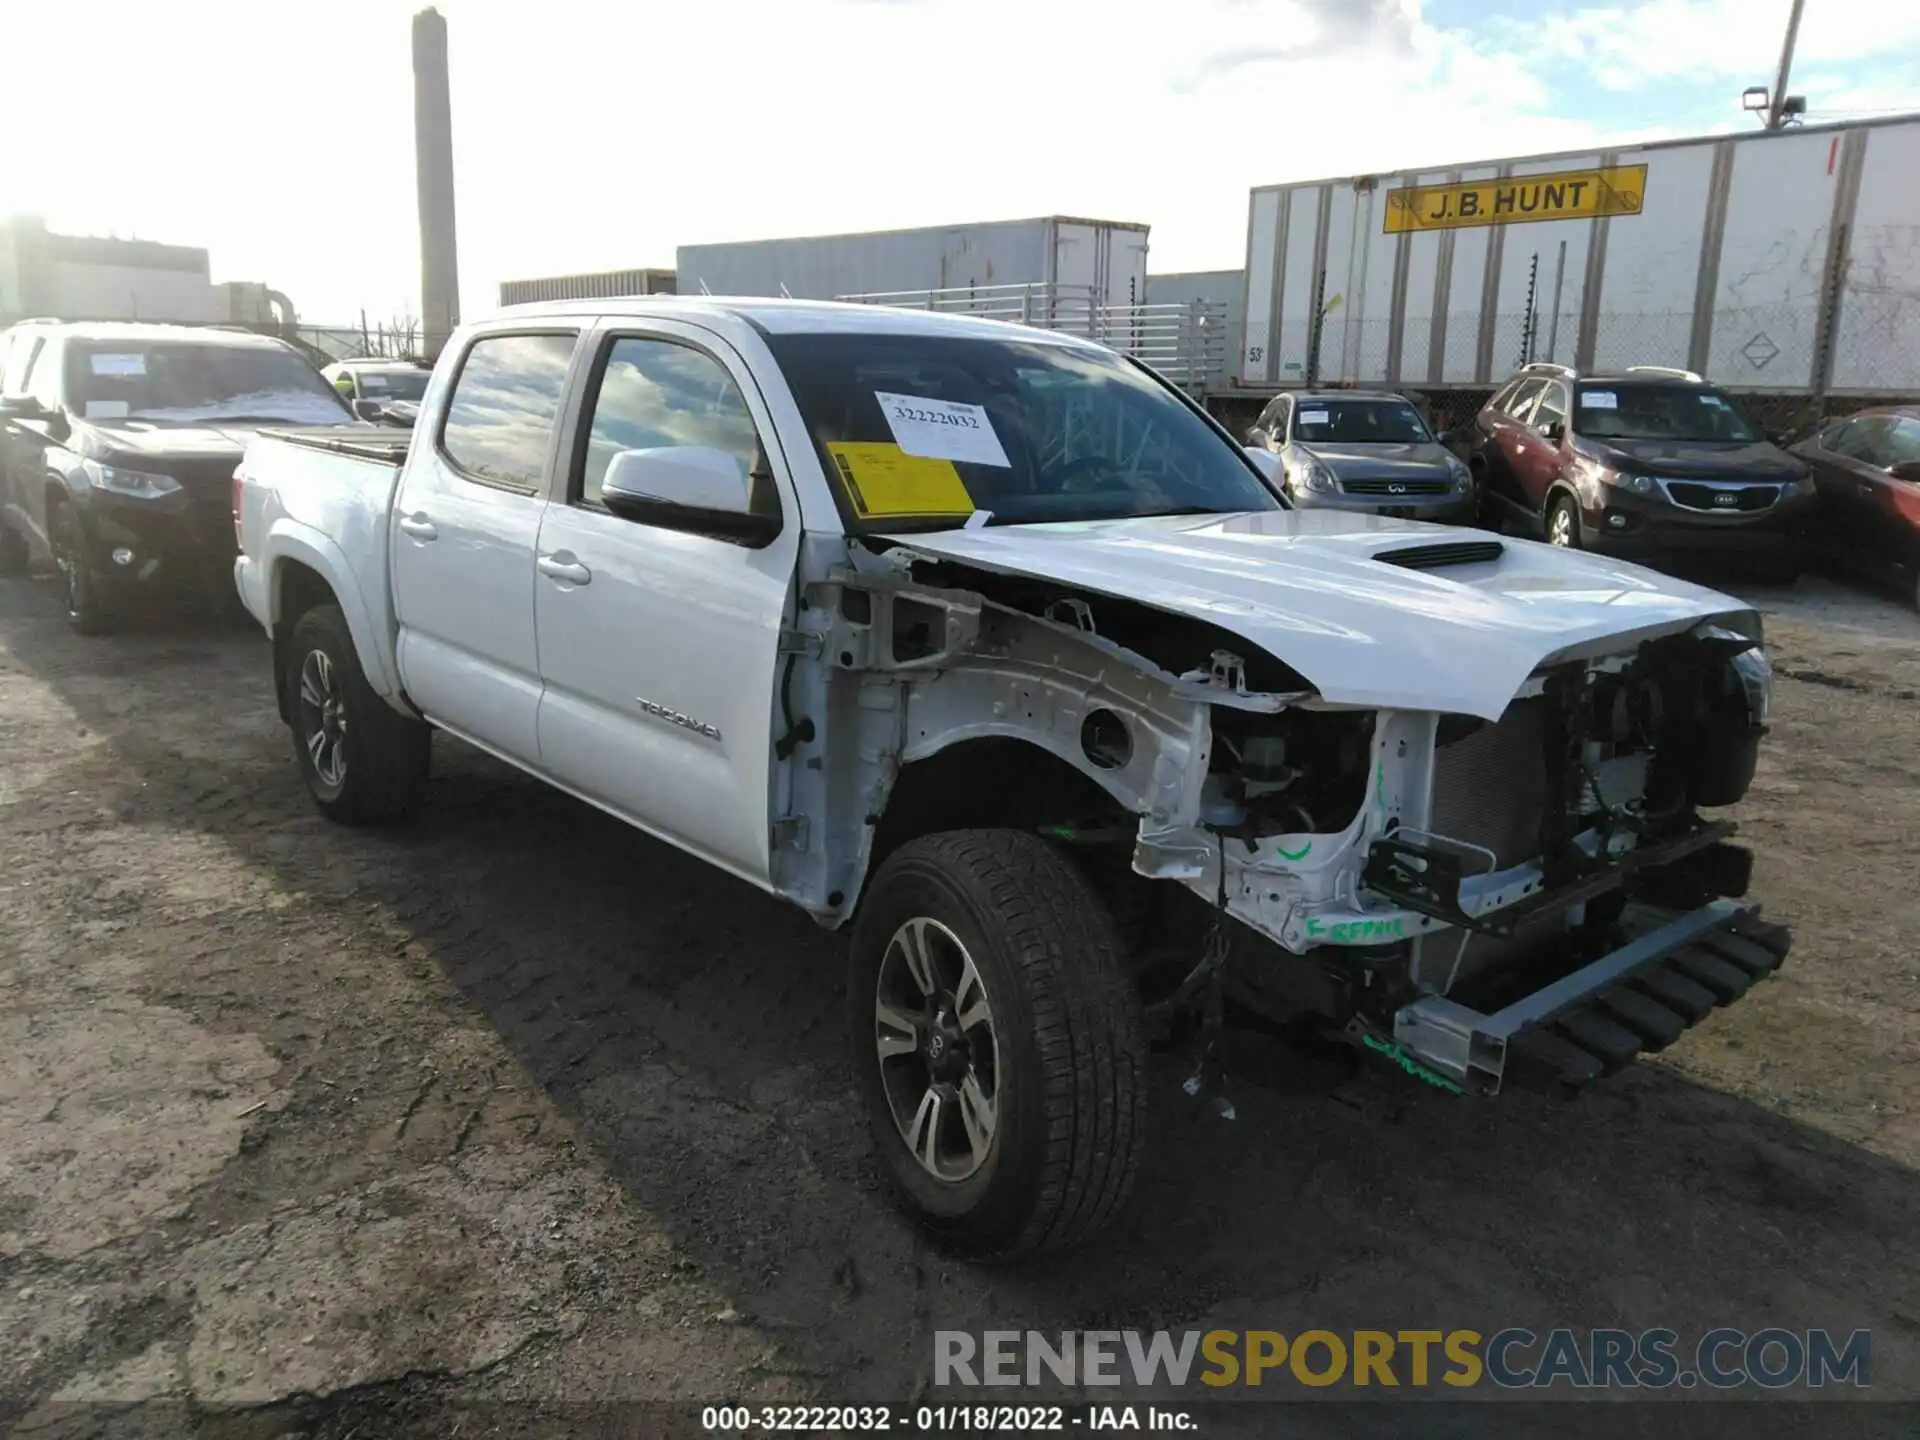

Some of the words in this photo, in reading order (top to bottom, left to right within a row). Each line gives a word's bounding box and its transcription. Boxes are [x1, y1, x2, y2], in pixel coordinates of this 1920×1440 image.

[1430, 191, 1485, 220] J.B.
[1495, 181, 1589, 213] HUNT
[894, 406, 980, 429] 32222032
